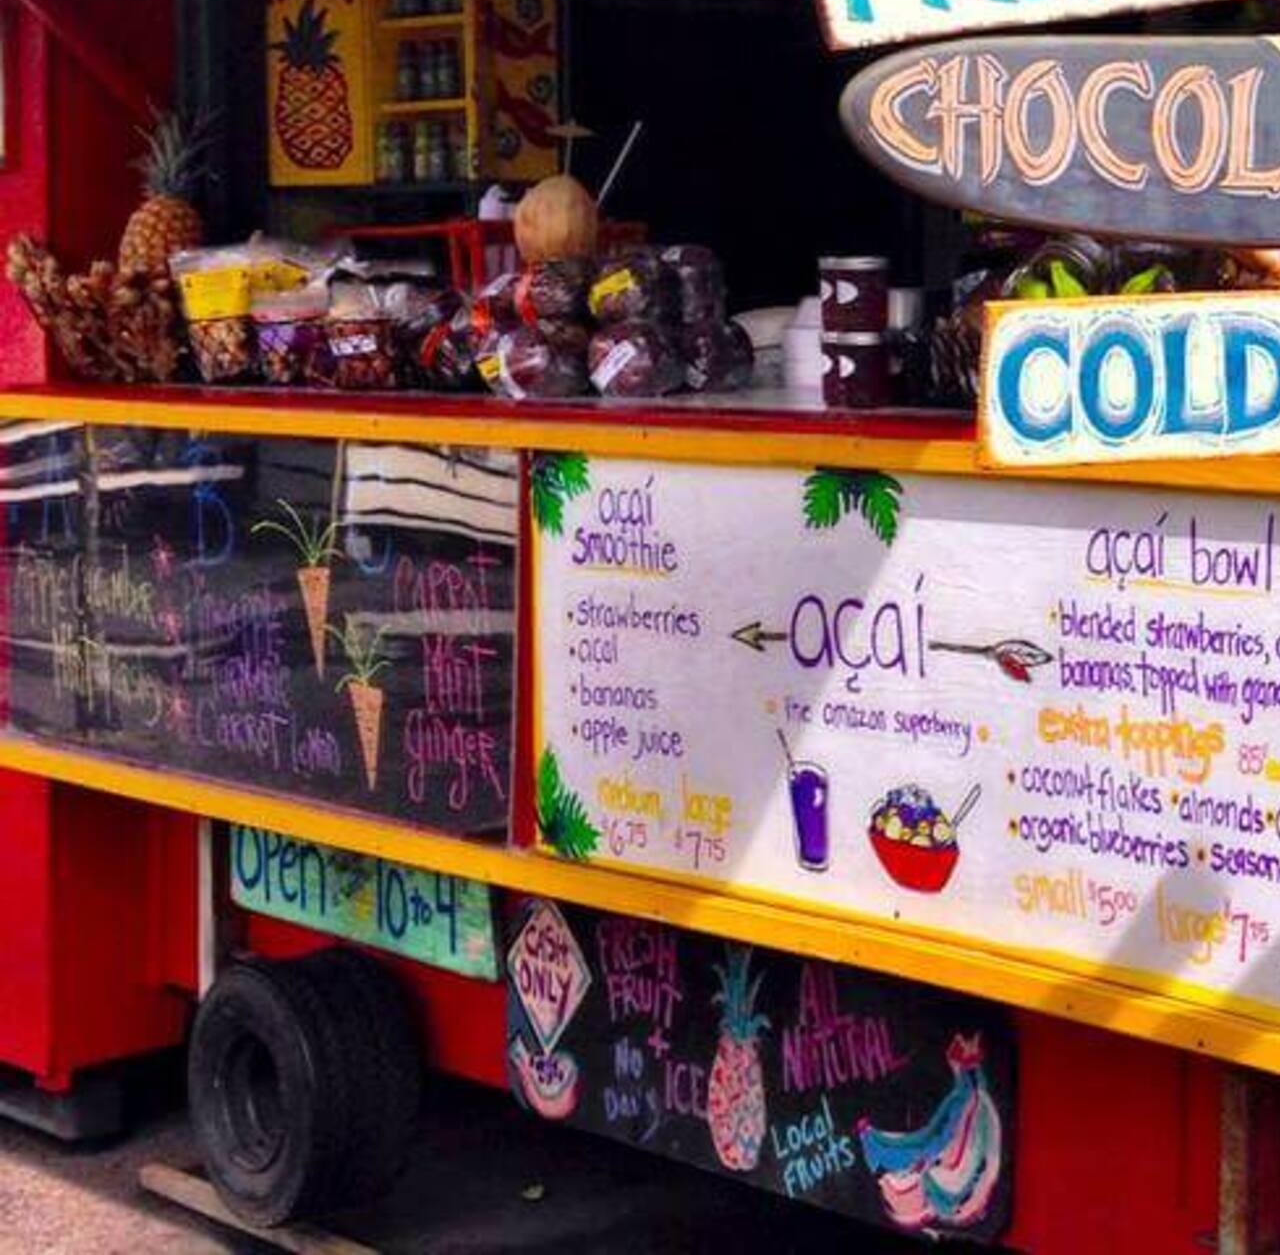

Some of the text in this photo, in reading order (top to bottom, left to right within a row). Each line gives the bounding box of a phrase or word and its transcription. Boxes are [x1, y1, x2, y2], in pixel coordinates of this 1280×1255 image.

[1190, 512, 1275, 592] bowl
[577, 595, 701, 638] strawberries
[787, 573, 928, 695] açaí
[1058, 600, 1137, 645] blended
[580, 671, 660, 711] bananas
[1135, 651, 1200, 716] topped
[580, 715, 684, 760] apple juice
[822, 701, 888, 732] amazon
[1114, 703, 1227, 785] toppings
[1021, 763, 1098, 803] coconut
[1098, 765, 1164, 815] flakes
[1178, 790, 1265, 835] almonds
[1018, 813, 1089, 853] organic
[375, 857, 407, 939] 10
[436, 873, 457, 955] 4
[1013, 867, 1088, 921] small
[524, 922, 571, 966] CASH
[519, 958, 573, 1028] ONLY
[606, 973, 684, 1029] FRUIT
[663, 1060, 709, 1119] ICE
